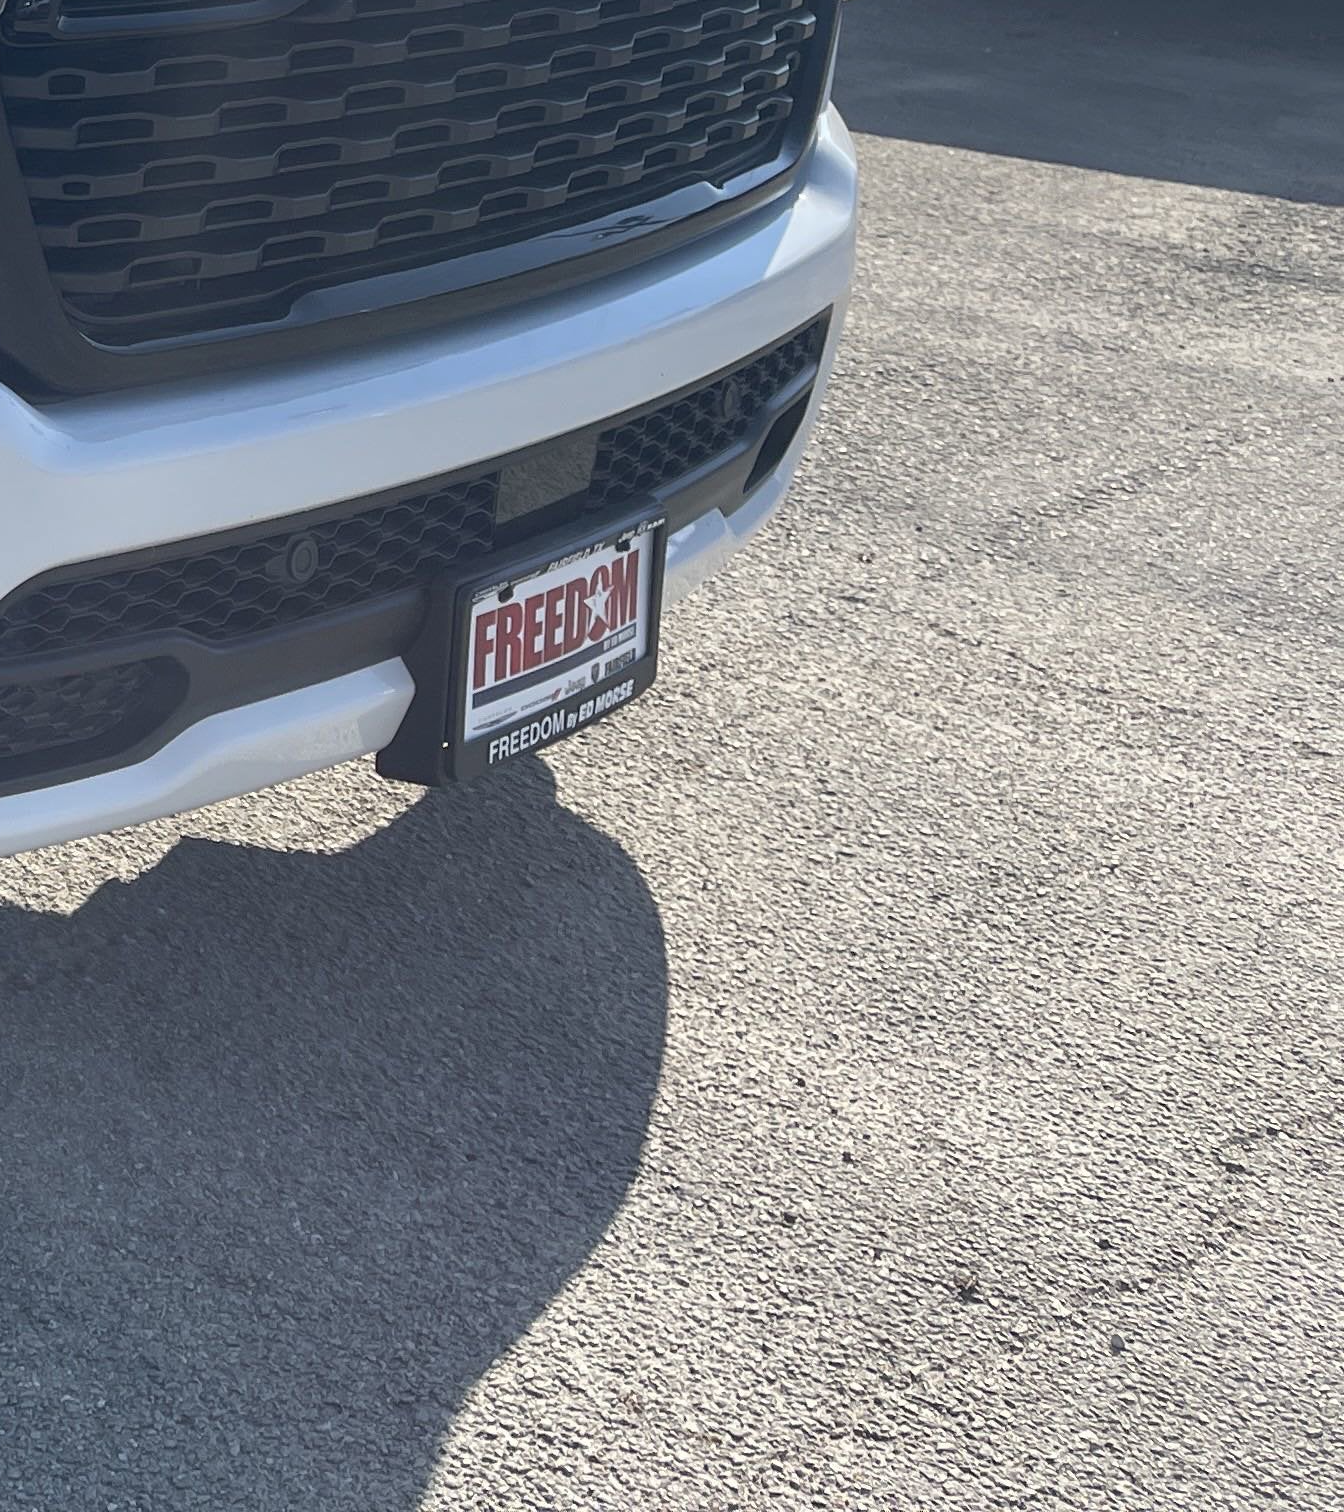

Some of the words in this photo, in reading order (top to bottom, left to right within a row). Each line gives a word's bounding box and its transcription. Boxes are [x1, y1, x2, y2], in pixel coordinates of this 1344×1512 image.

[473, 549, 640, 690] FREEDOM
[489, 709, 565, 764] FREEDOM
[579, 700, 594, 722] ED
[595, 679, 635, 713] MORSE
